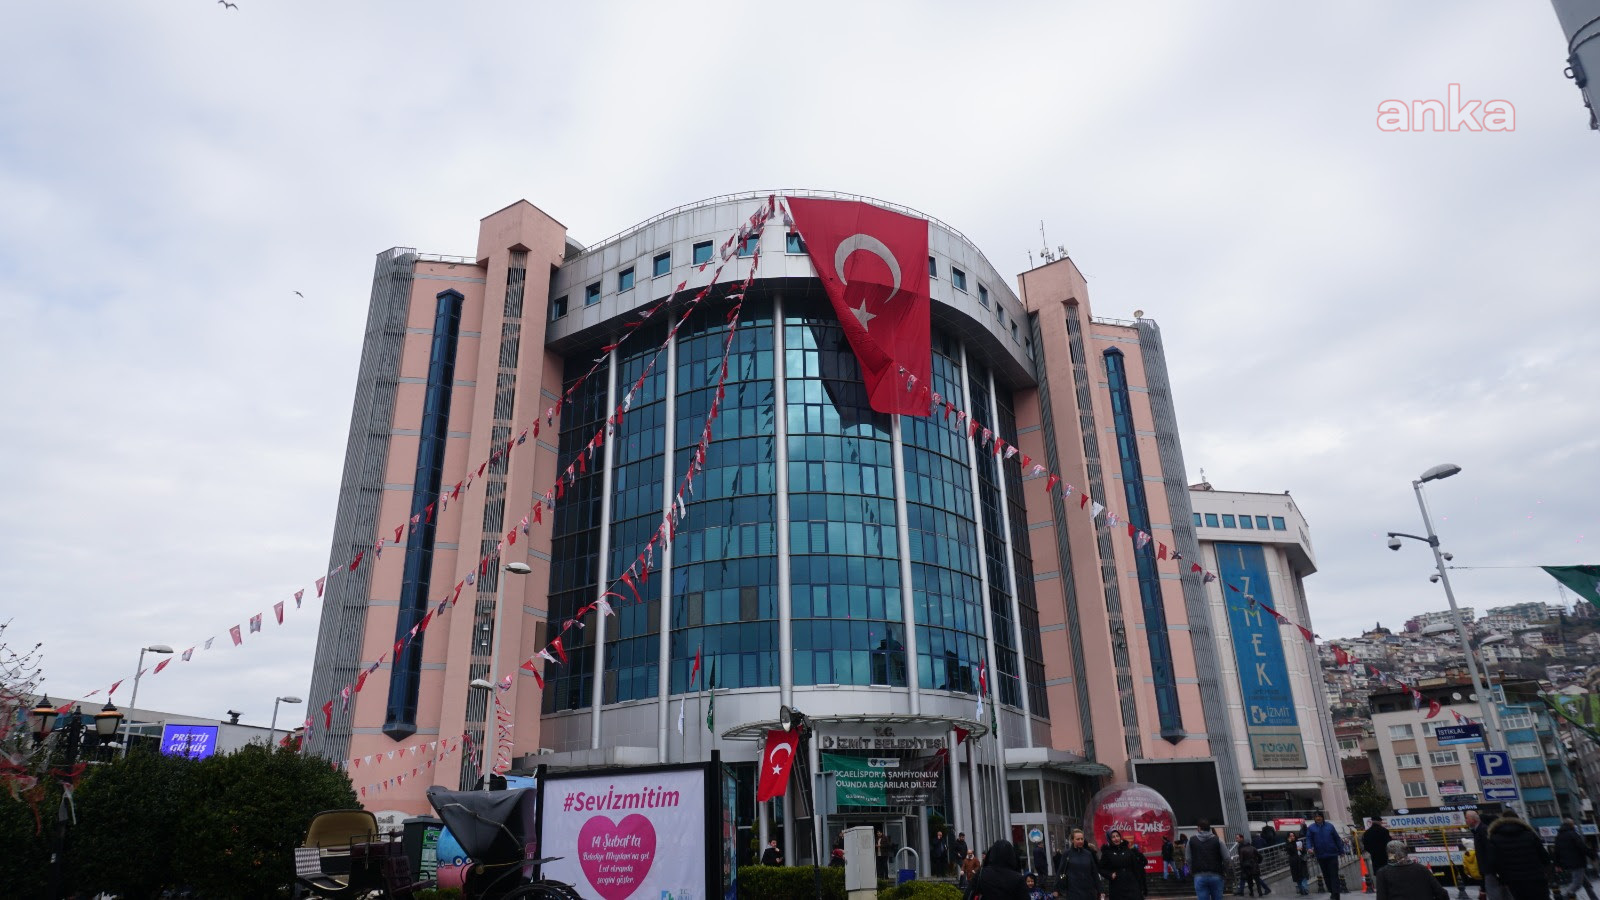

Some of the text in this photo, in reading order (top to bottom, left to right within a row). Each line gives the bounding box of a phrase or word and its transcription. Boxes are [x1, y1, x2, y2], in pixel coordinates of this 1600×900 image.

[1238, 547, 1273, 687] İZMEK
[873, 727, 895, 737] T.C.
[837, 735, 945, 749] İZMİT BELEDİYESİ
[1483, 754, 1503, 775] P
[835, 769, 939, 780] OCAELİSPOR'A ŞAMPİYONLUK
[835, 780, 937, 790] OLUNDA BAŞARILAR DİLERİZ
[563, 784, 680, 812] #Sevİzmitim
[1391, 817, 1427, 827] OTOPARK
[591, 833, 641, 850] 14 Şubat'ta
